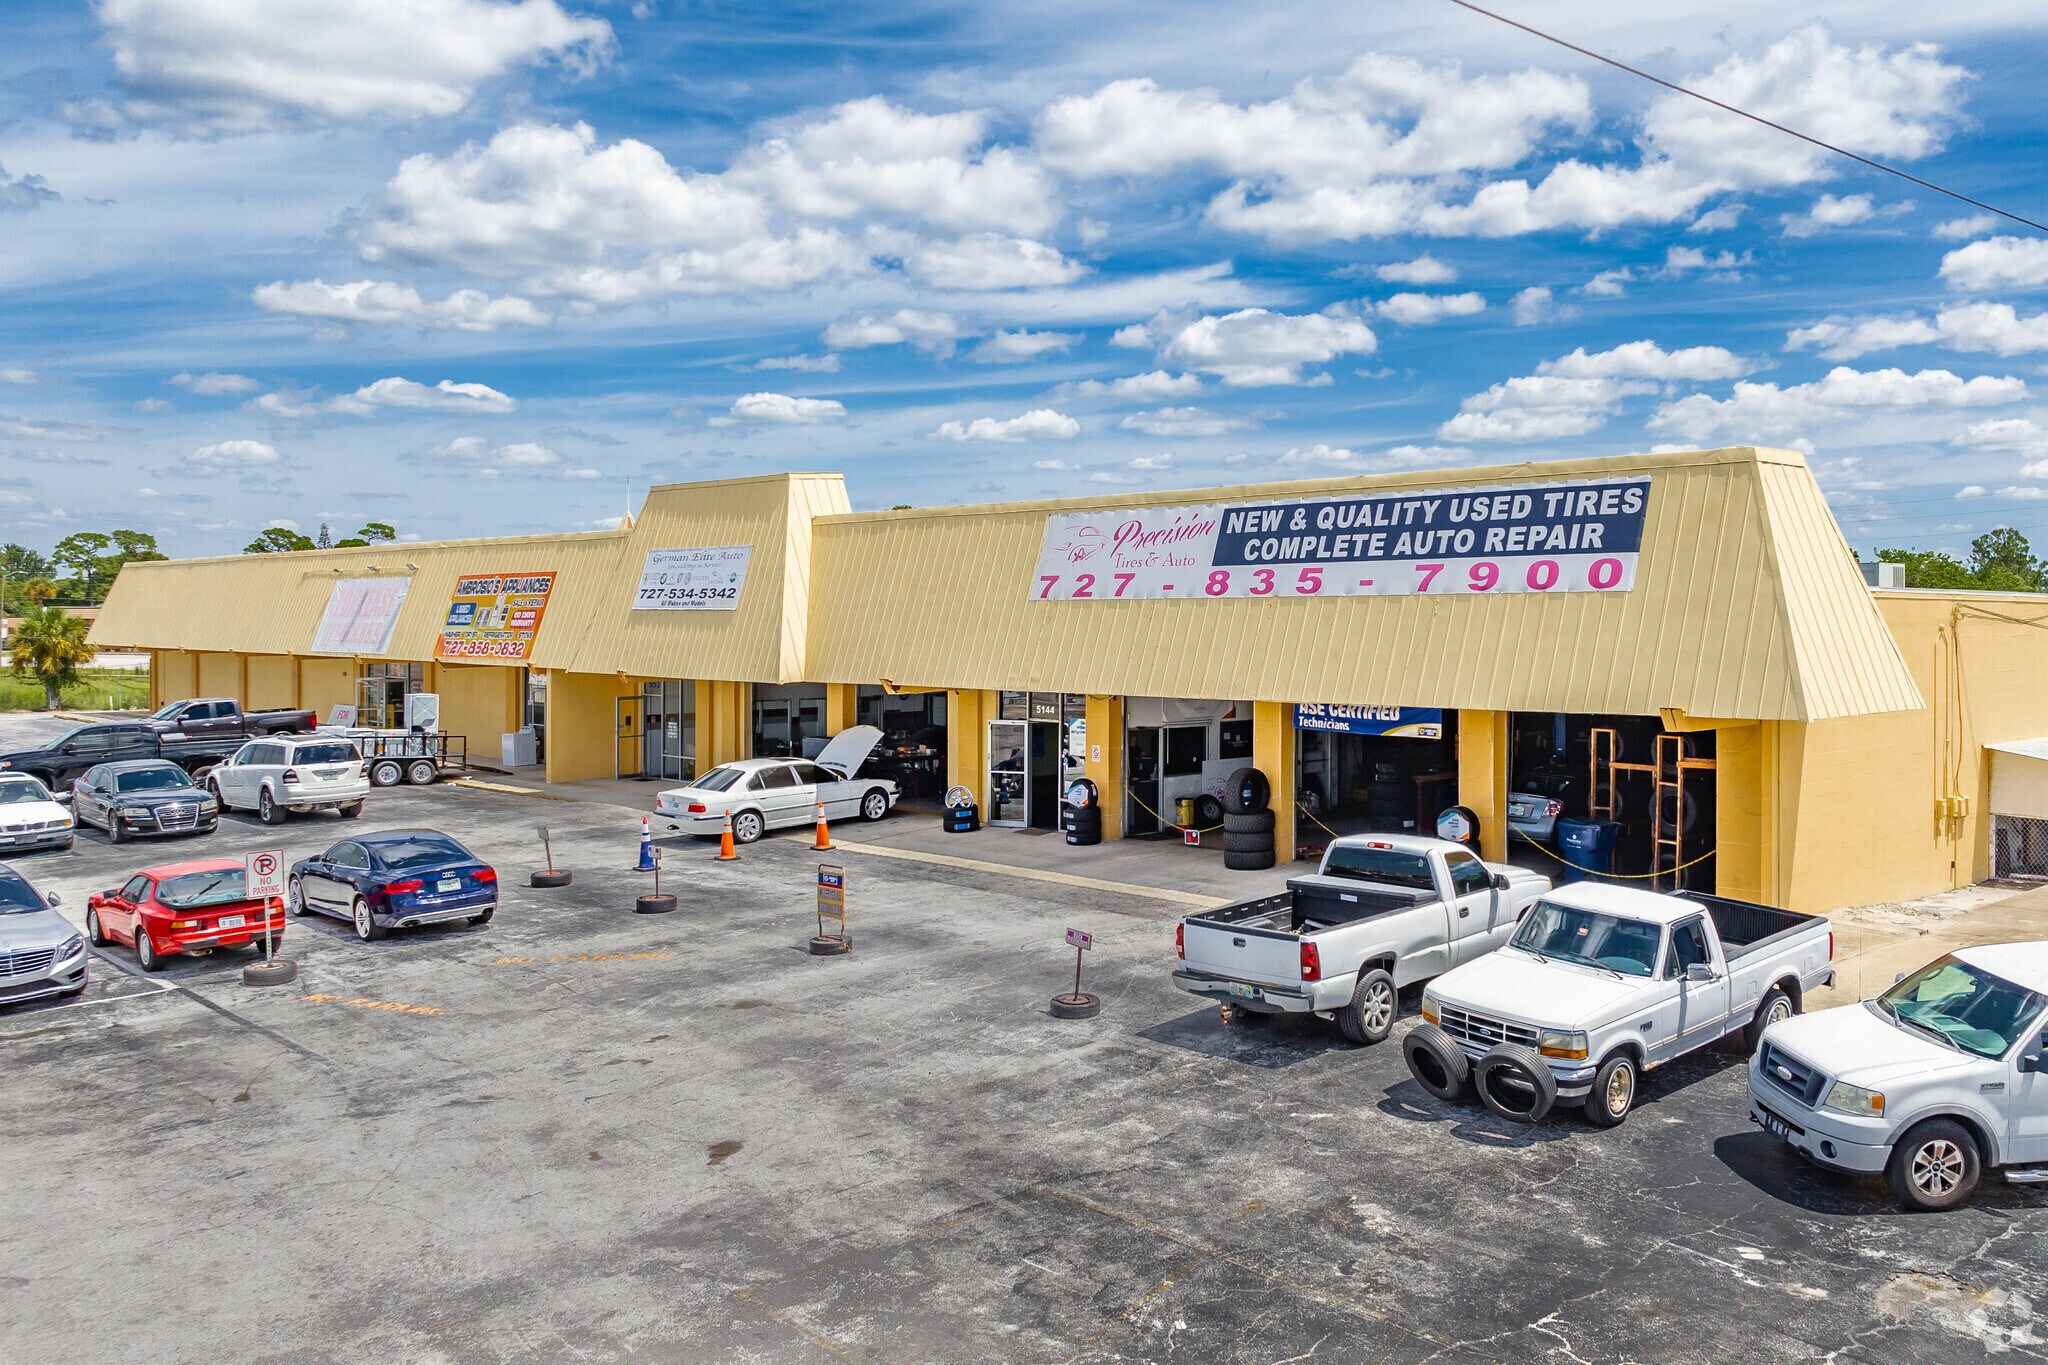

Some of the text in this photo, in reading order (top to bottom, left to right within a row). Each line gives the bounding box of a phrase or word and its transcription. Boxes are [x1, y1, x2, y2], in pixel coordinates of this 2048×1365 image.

[1227, 488, 1643, 534] NEW & QUALITY USED TIRES
[1244, 523, 1605, 561] COMPLETE AUTO REPAIR
[653, 551, 743, 565] German Elite Auto
[1115, 552, 1195, 568] Tires & Auto
[456, 577, 551, 595] AMBROSIO'S APPLIANCES
[640, 588, 736, 599] 727-534-5342
[527, 598, 544, 606] REPAIR
[456, 605, 471, 613] USED
[448, 614, 473, 623] APPLIANCES
[510, 619, 534, 627] WARRANTY
[443, 641, 524, 656] 727-858-0832
[337, 710, 349, 720] FOR
[1036, 706, 1055, 714] 5144
[1299, 704, 1400, 721] ASE CERTIFIED
[1299, 716, 1350, 730] Technicians
[260, 877, 271, 885] NO
[253, 885, 279, 895] PARKING
